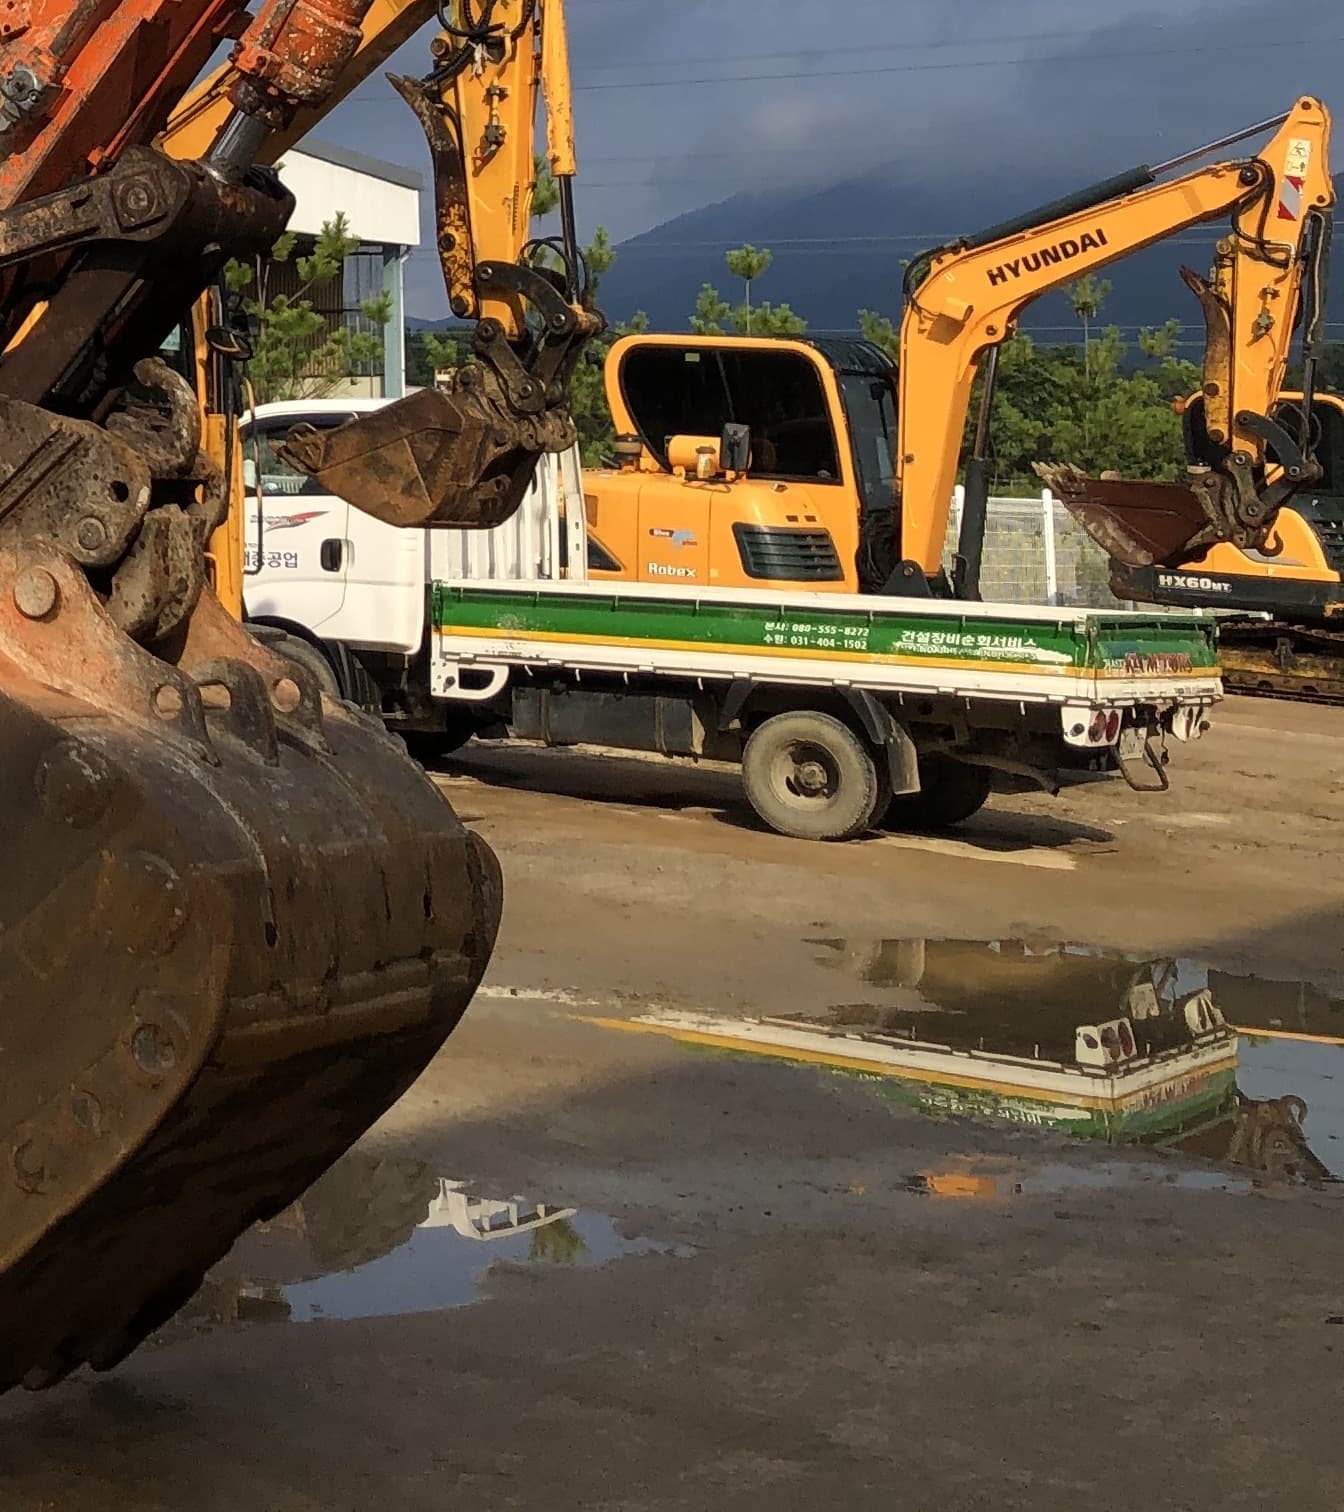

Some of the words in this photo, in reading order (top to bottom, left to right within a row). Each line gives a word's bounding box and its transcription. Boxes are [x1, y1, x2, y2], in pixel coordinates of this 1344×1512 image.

[986, 228, 1108, 287] HYUNDAI
[648, 562, 697, 577] Robex
[790, 636, 868, 650] 031-404-1502
